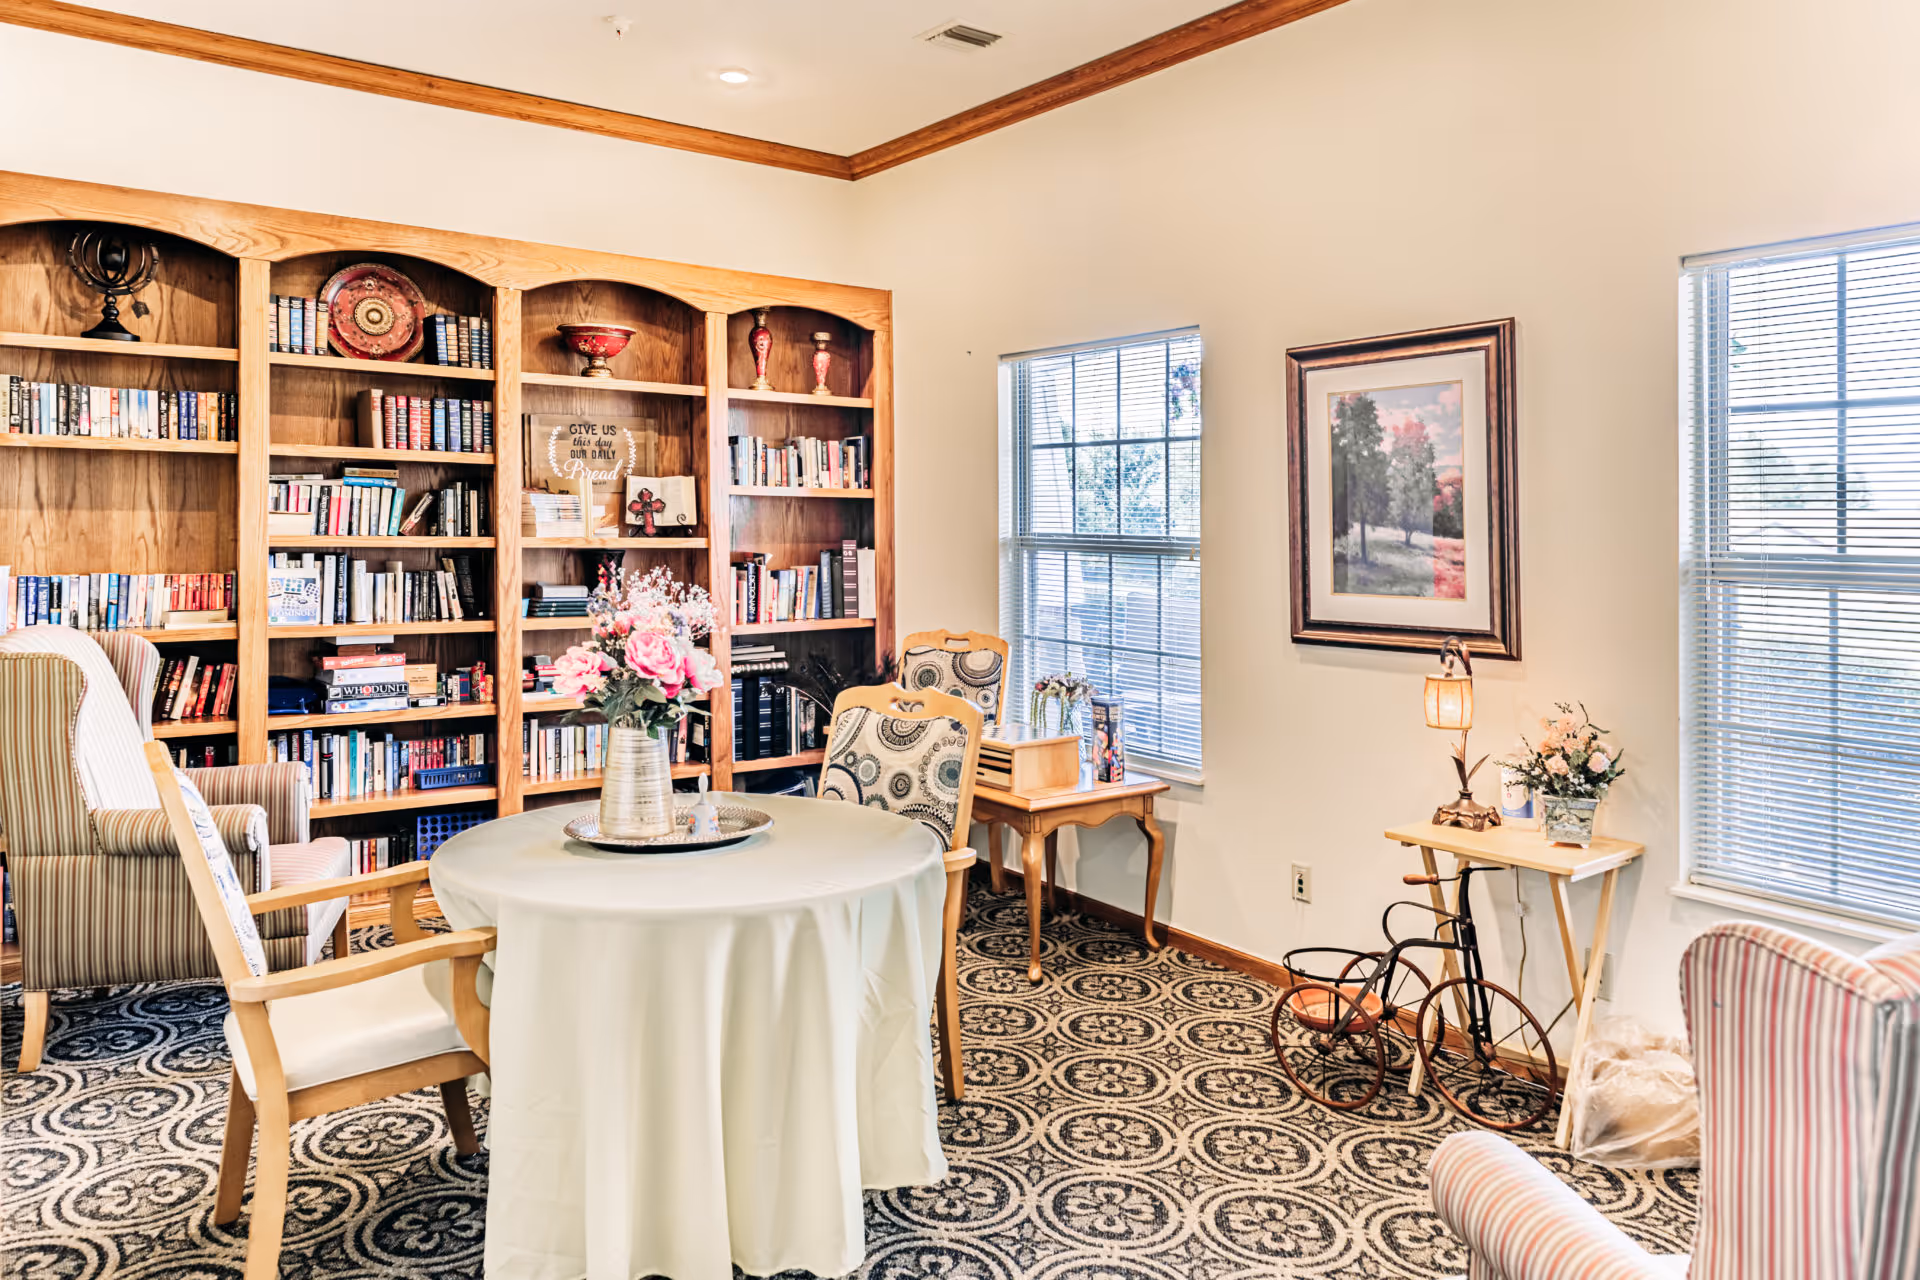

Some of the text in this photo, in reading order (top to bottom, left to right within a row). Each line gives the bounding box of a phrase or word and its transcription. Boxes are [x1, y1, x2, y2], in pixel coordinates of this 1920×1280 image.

[569, 424, 617, 436] GIVE US
[573, 436, 613, 449] this day
[570, 449, 616, 460] OUR DAILY
[563, 459, 624, 480] Bread
[748, 575, 756, 615] DICTIONARY
[343, 684, 407, 696] WHODUNIT
